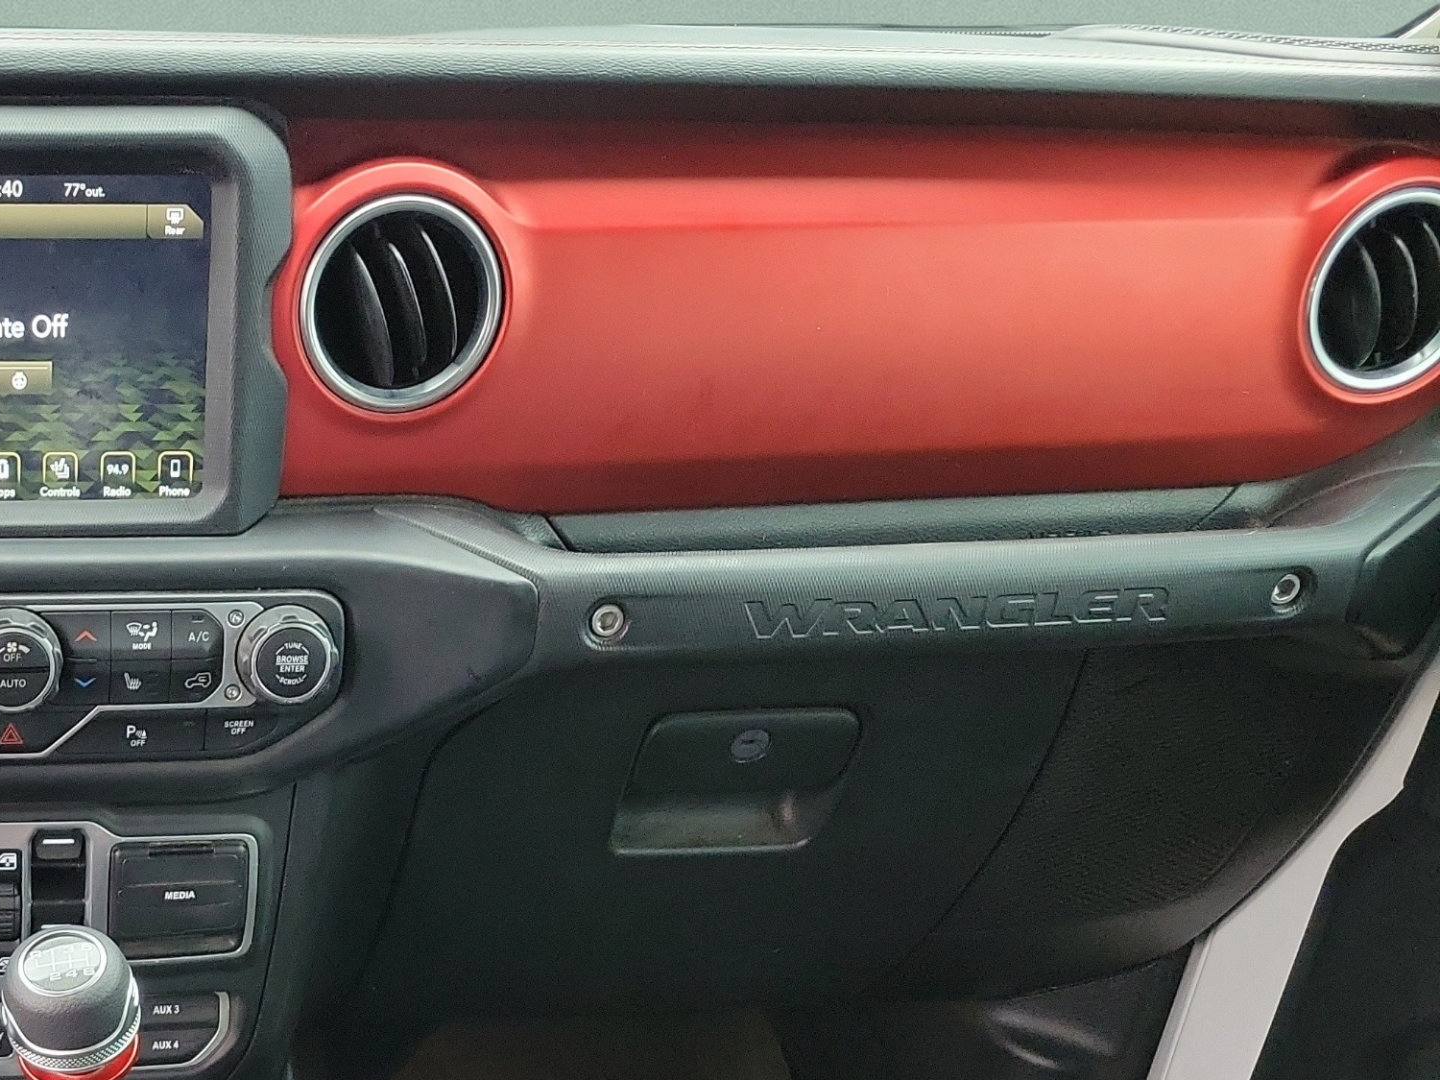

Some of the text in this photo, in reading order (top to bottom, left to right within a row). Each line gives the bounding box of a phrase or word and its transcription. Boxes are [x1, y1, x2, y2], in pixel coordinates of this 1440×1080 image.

[164, 225, 185, 236] Rear
[31, 314, 69, 339] Off
[106, 464, 129, 475] 94.9
[40, 487, 80, 497] Controls
[103, 487, 131, 497] Radio
[159, 486, 190, 497] Phone
[744, 587, 1169, 639] WRANGLER
[188, 632, 210, 642] A/C
[284, 642, 302, 650] TUNE
[3, 653, 22, 662] OFF
[276, 655, 308, 664] BROWSE
[279, 664, 305, 673] ENTER
[0, 679, 27, 689] AUTO
[278, 676, 304, 685] SCROLL
[224, 720, 254, 728] SCREEN
[130, 739, 146, 747] OFF
[164, 890, 196, 900] MEDIA
[66, 969, 79, 978] 4
[152, 1005, 180, 1015] AUX 3
[152, 1041, 179, 1050] AUX 4
